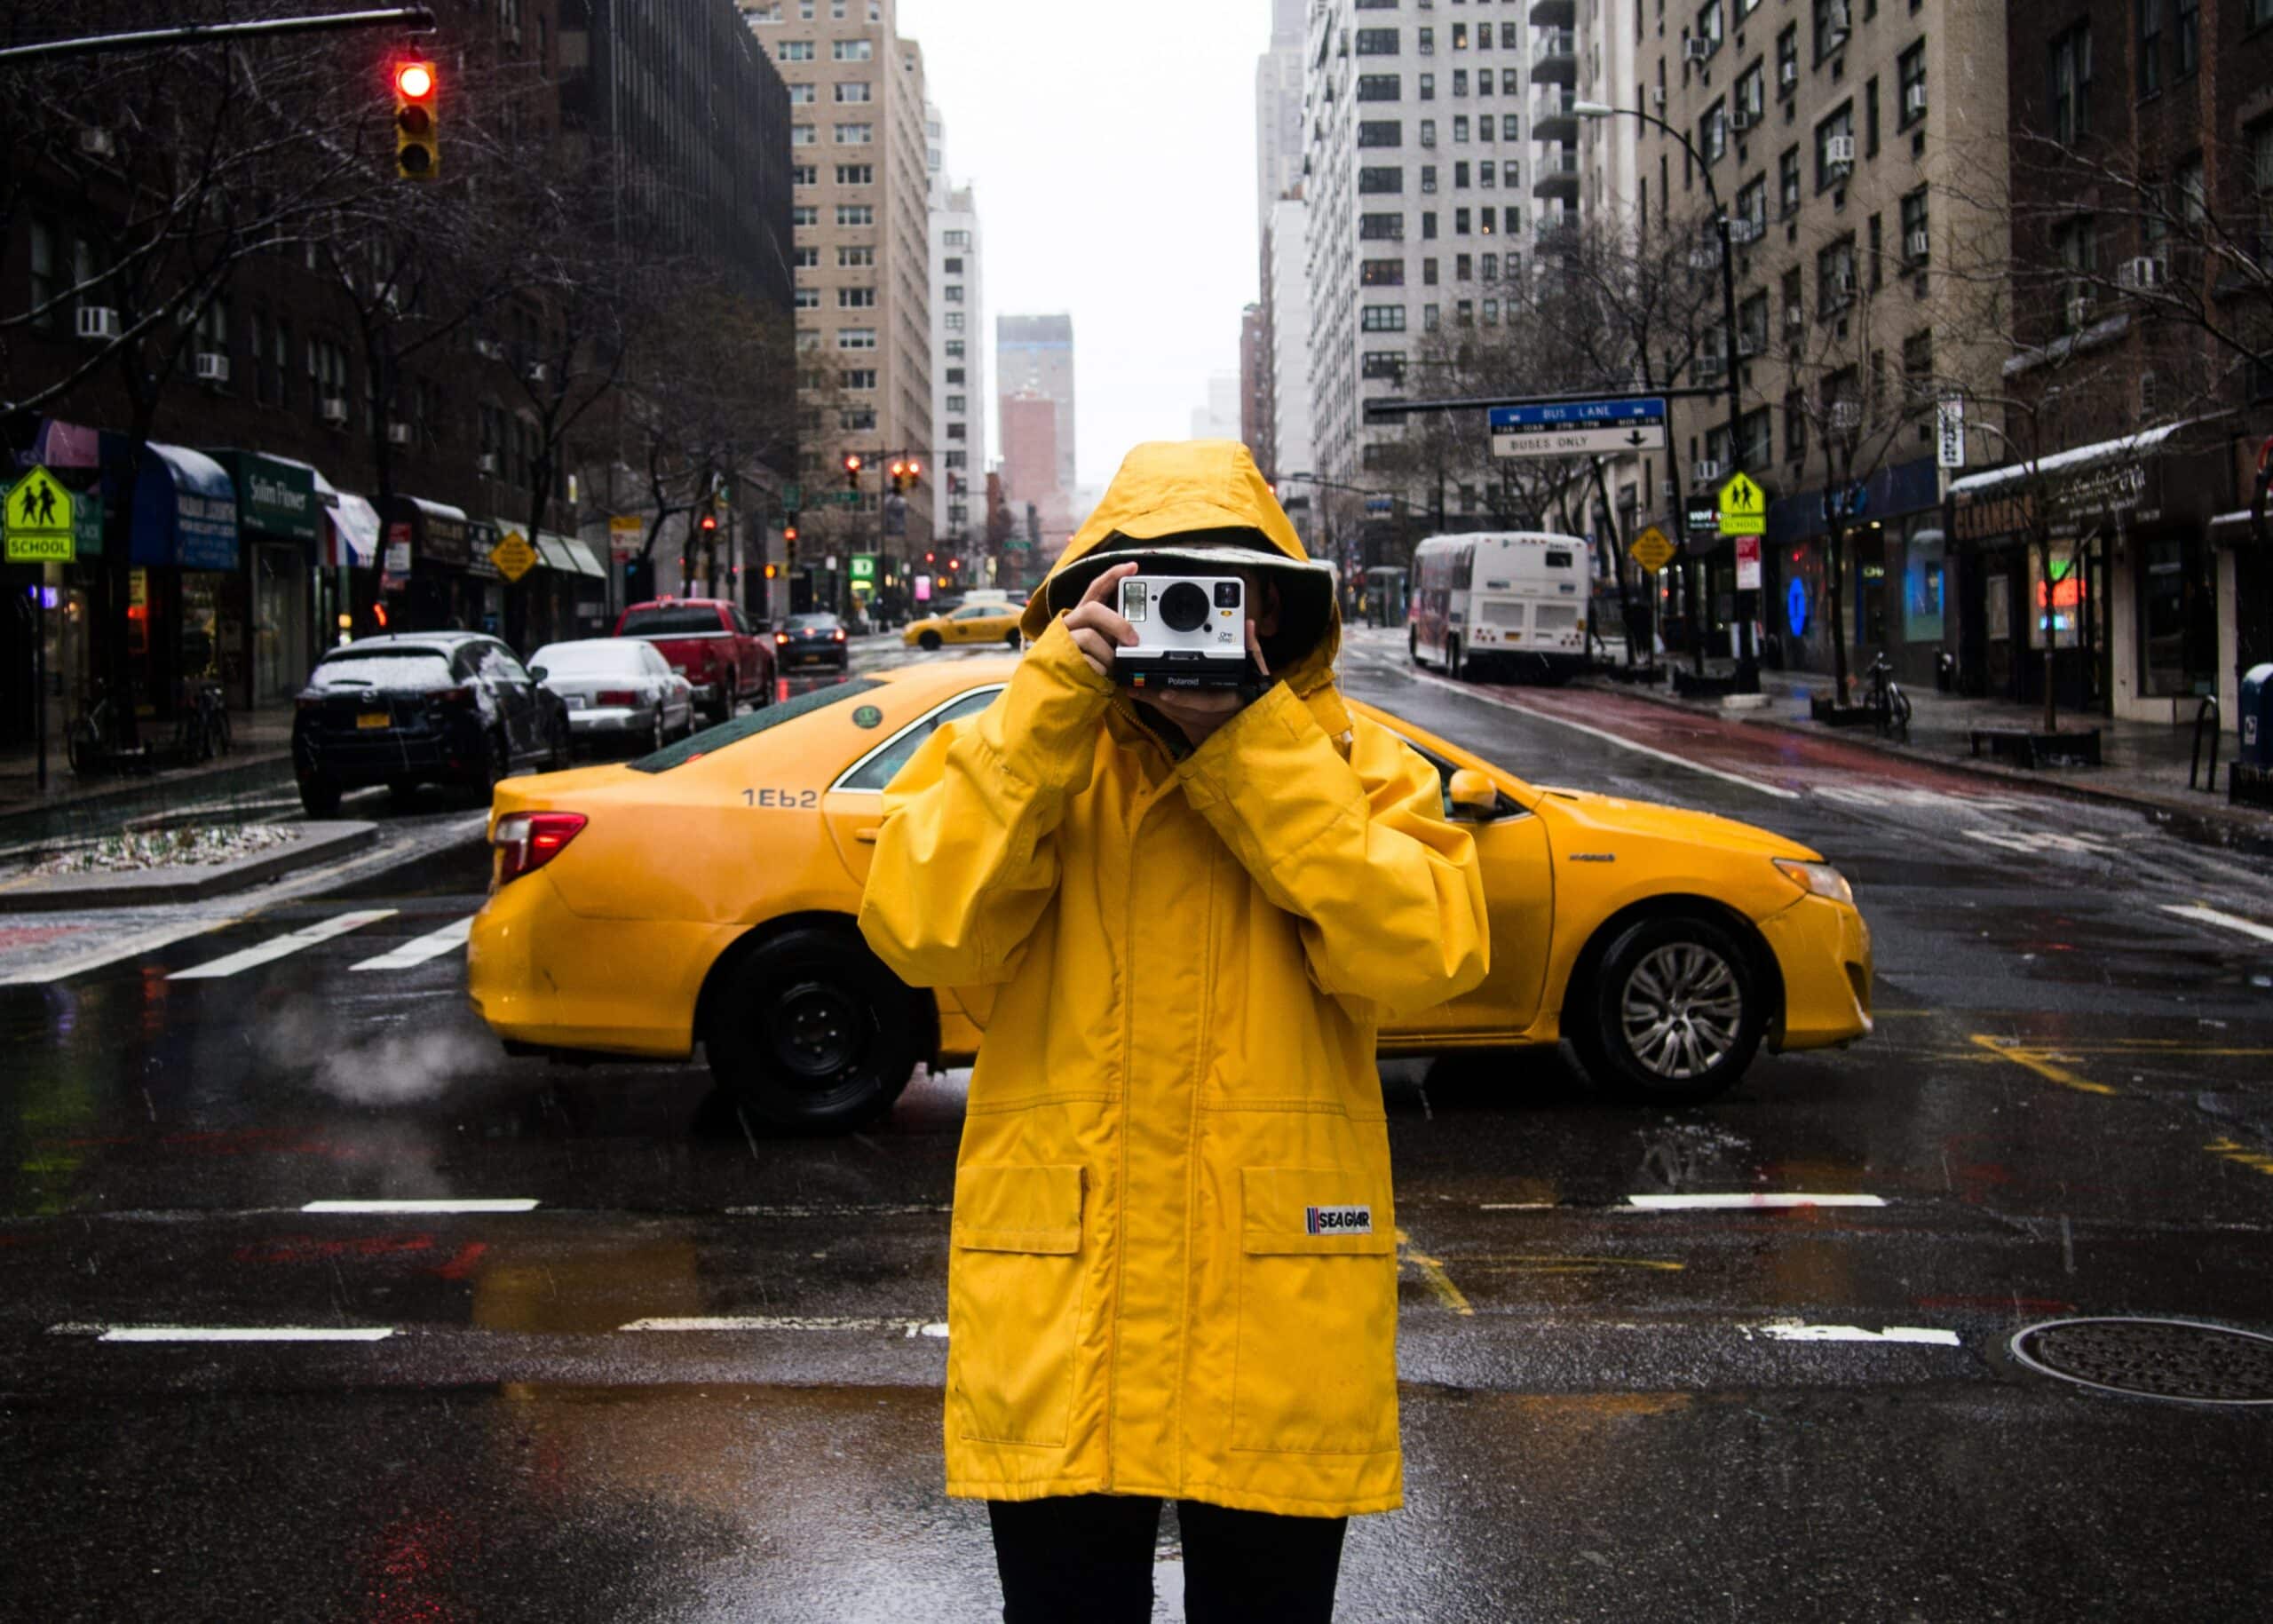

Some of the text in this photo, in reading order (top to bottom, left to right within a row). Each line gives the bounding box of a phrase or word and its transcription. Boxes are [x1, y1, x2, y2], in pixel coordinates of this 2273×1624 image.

[1542, 404, 1612, 420] BUS LANE
[1510, 436, 1589, 451] BUSES ONLY
[1724, 519, 1763, 530] SCHOOL
[11, 540, 68, 555] SCHOOL
[1168, 676, 1200, 686] Polaroid
